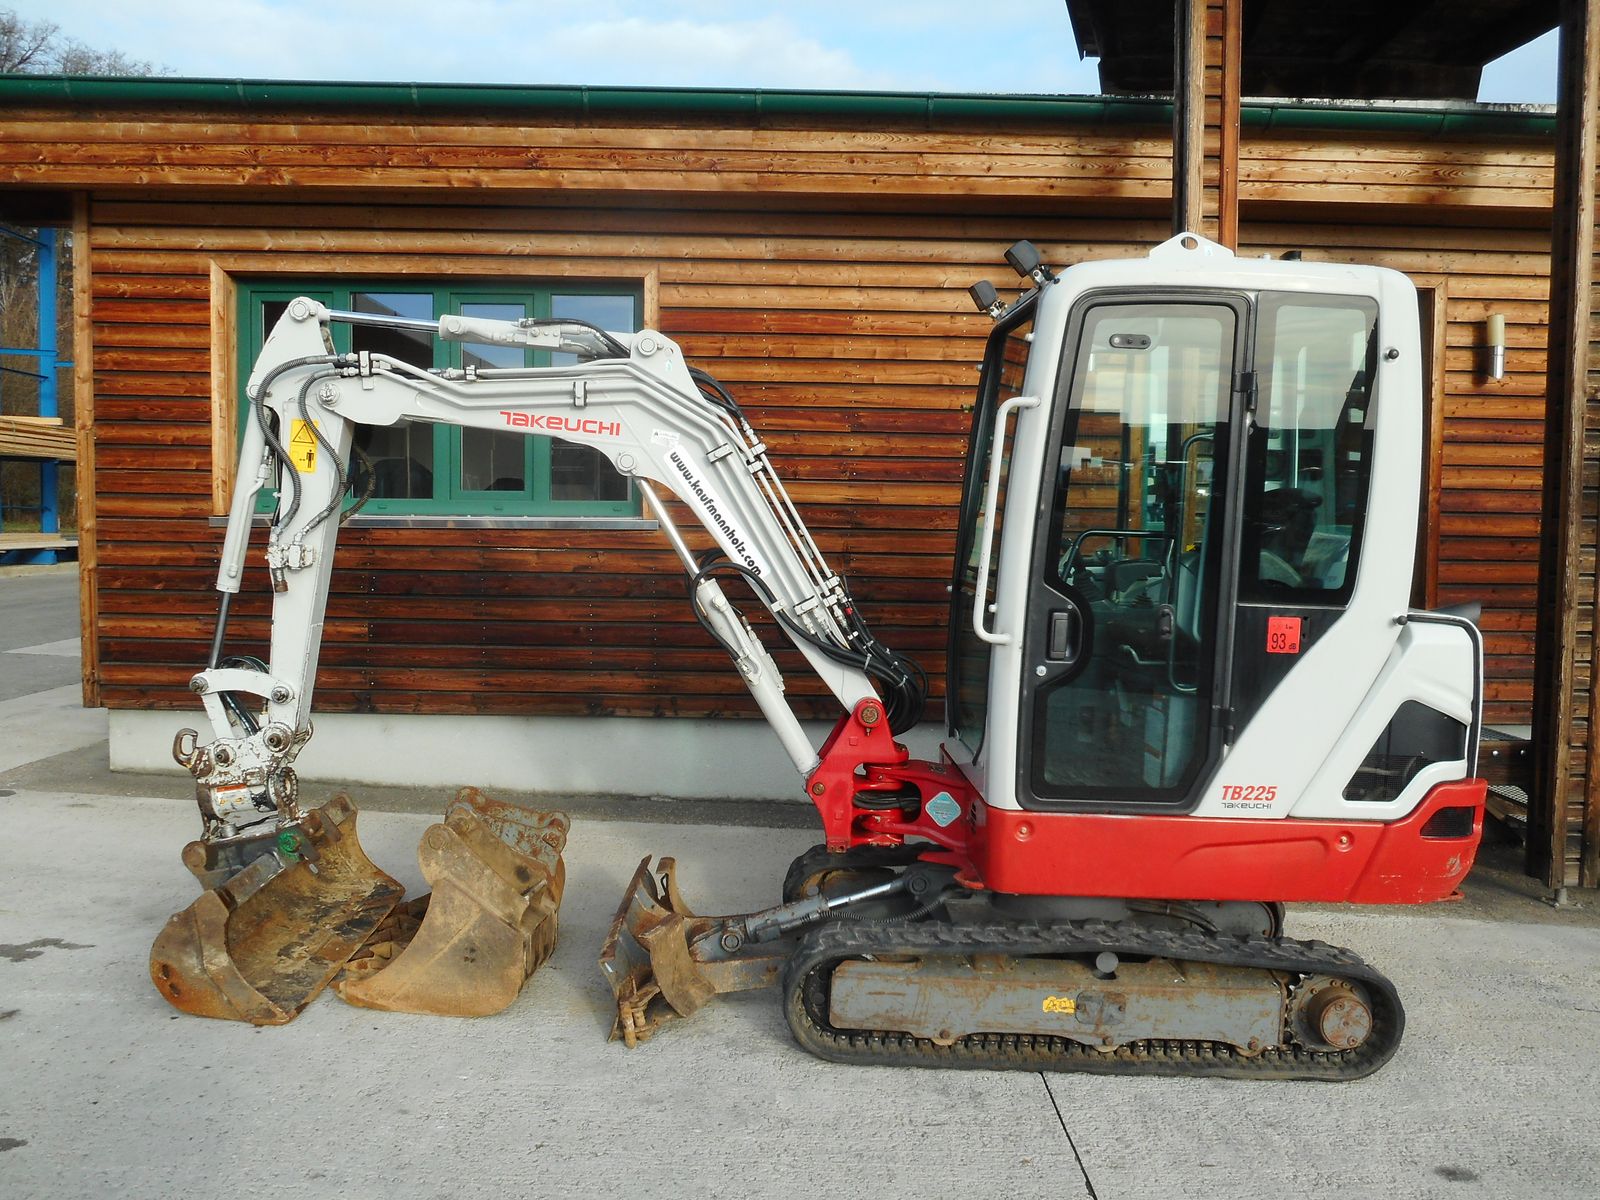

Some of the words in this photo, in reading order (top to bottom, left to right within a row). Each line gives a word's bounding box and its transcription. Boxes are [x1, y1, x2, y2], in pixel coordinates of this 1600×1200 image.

[500, 411, 620, 436] TAKEUCHI
[669, 451, 762, 576] www.kaufmannholz.com
[1271, 632, 1287, 650] 93
[1222, 785, 1278, 801] TB225
